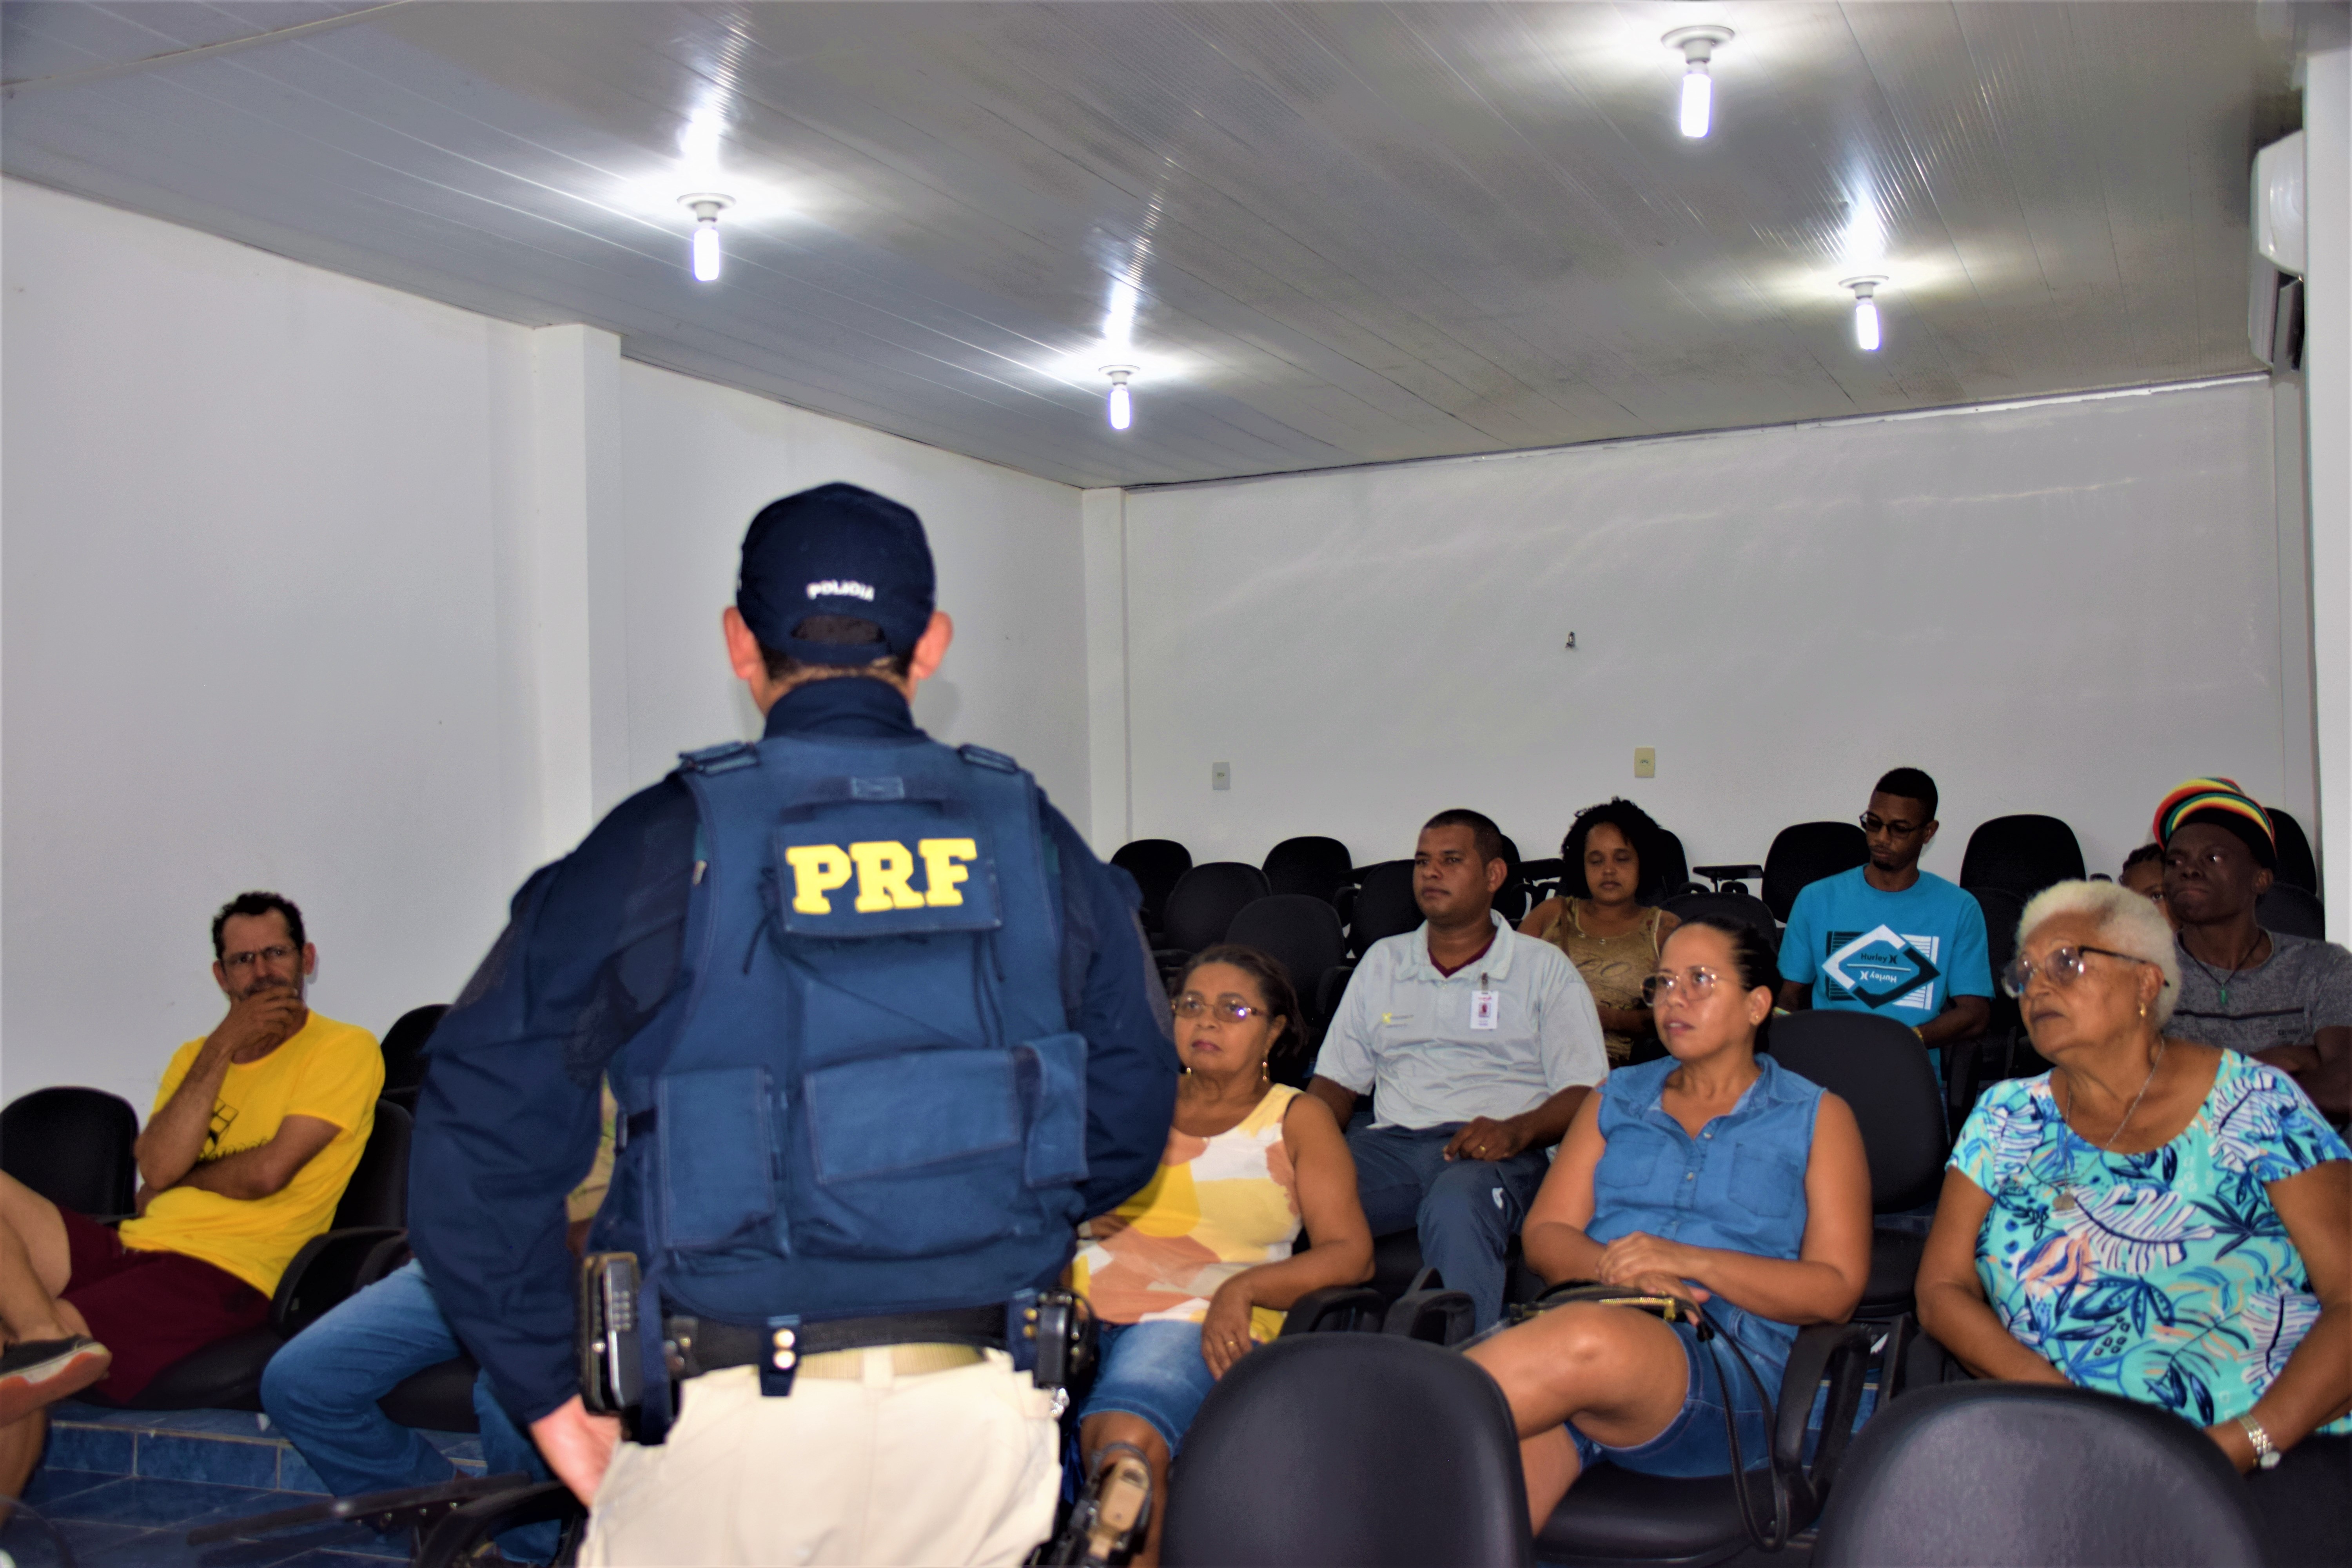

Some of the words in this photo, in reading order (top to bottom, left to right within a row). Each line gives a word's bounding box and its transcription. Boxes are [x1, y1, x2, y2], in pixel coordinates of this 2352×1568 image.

[785, 838, 977, 915] PRF
[1860, 953, 1887, 963] Hurley
[1869, 971, 1897, 983] Hurley
